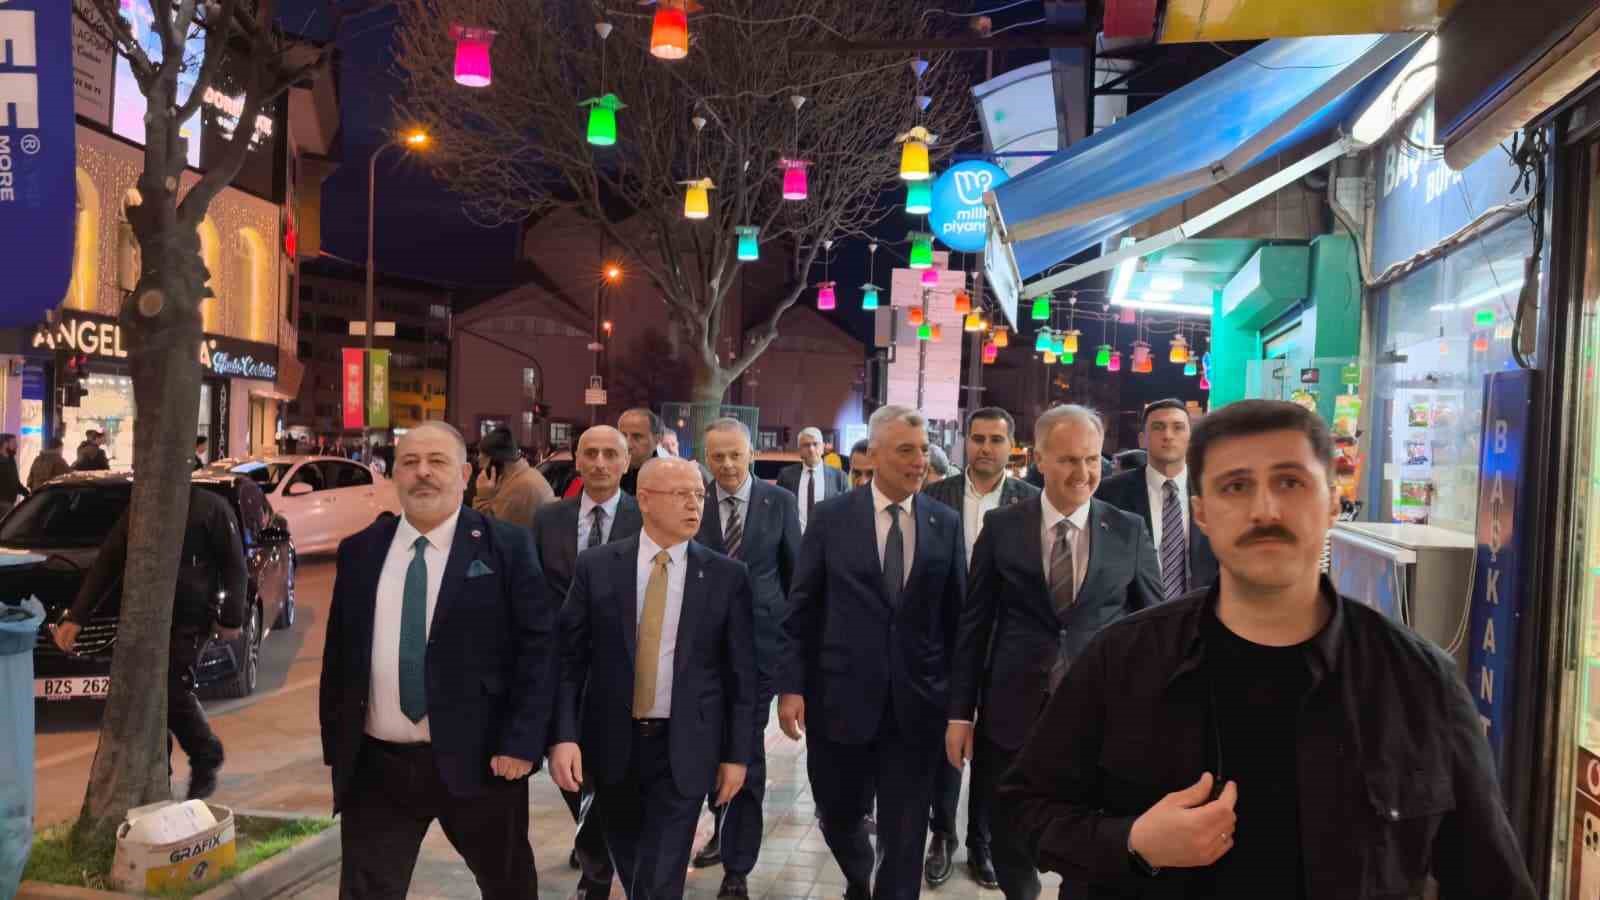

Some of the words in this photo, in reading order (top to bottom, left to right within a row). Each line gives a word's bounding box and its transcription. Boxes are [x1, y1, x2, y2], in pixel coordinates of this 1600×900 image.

[0, 135, 15, 202] MORE
[33, 319, 128, 358] ANGEL
[45, 679, 73, 695] BZS
[169, 833, 222, 864] GRAFIX
